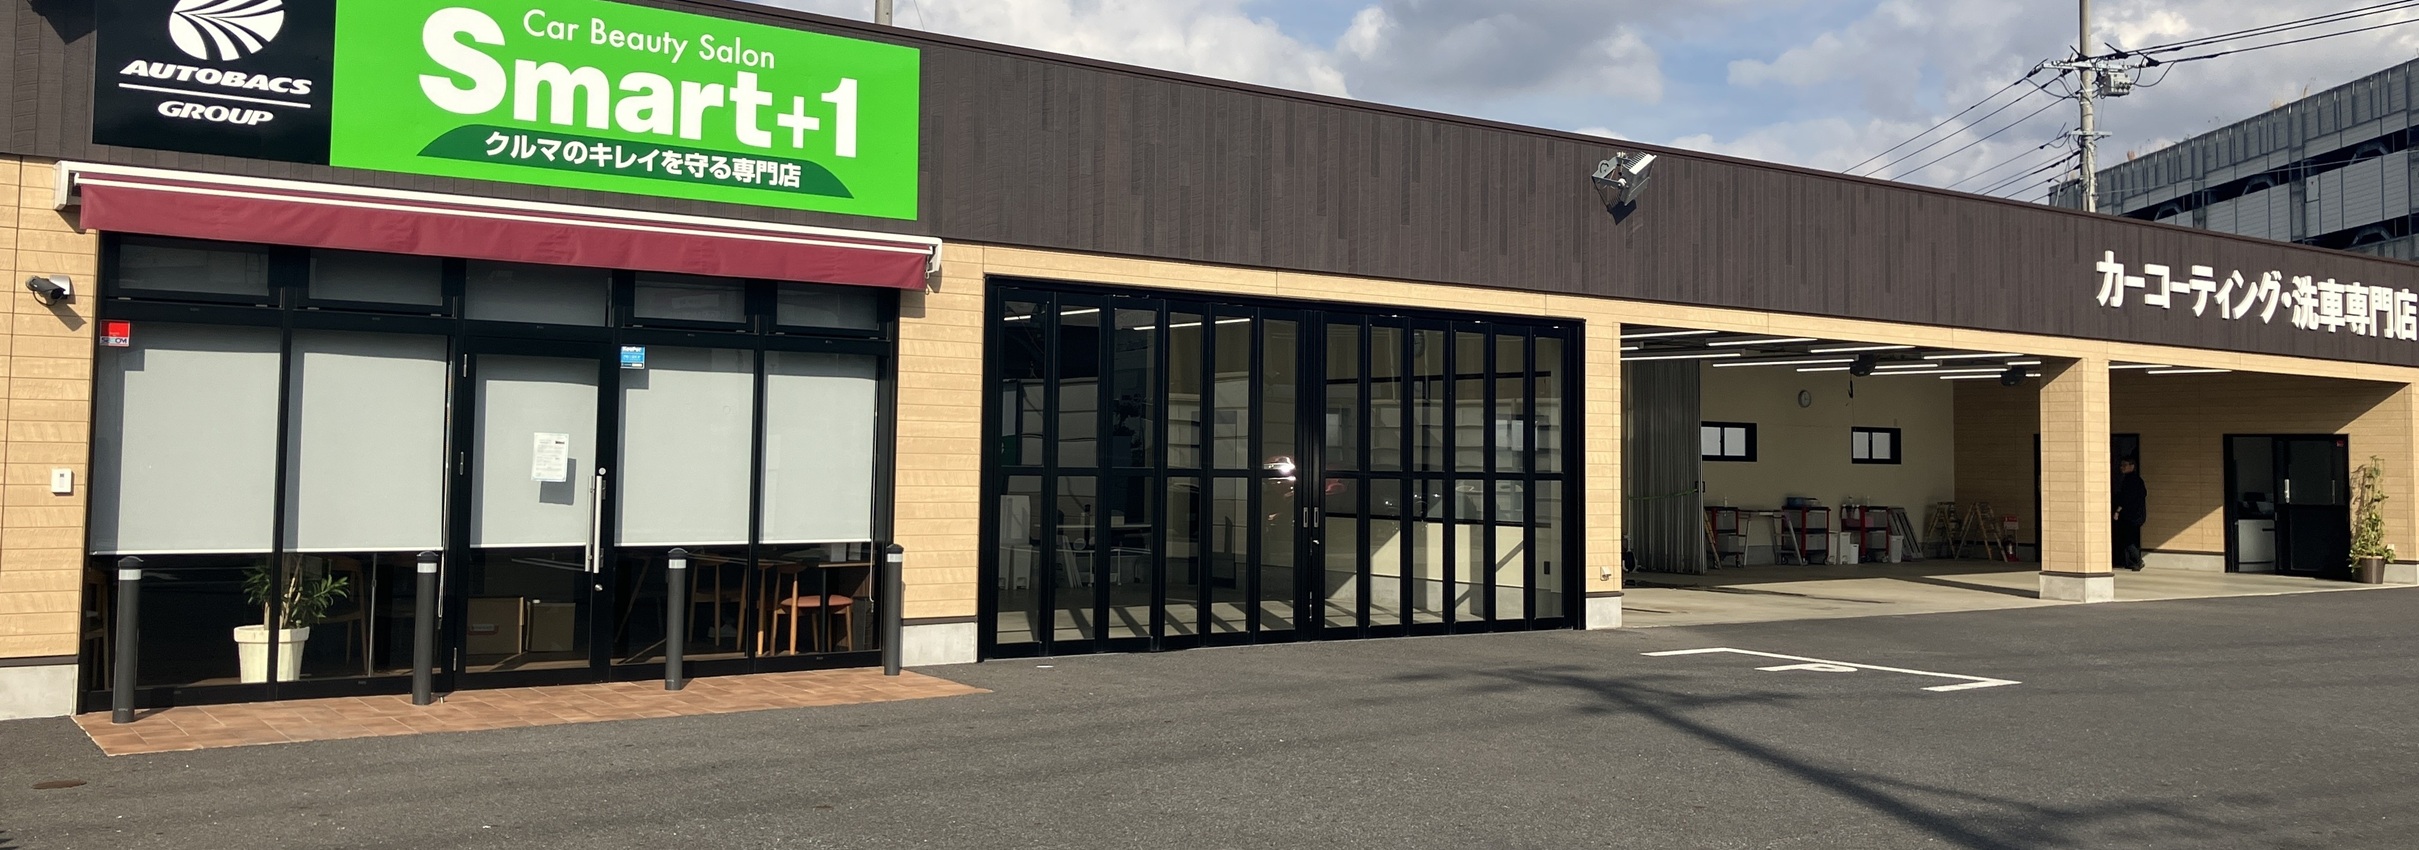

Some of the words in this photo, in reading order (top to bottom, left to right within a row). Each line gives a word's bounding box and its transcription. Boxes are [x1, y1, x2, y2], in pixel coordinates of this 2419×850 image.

[523, 9, 579, 41] Car
[590, 18, 690, 64] Beauty
[699, 34, 776, 69] Salon
[119, 59, 313, 95] AUTOBACS
[418, 6, 859, 159] Smart+1
[157, 100, 275, 126] GROUP
[485, 130, 802, 189] クルマのキレイを守る専門店
[2095, 249, 2419, 342] カーコーティング・洗車専門店
